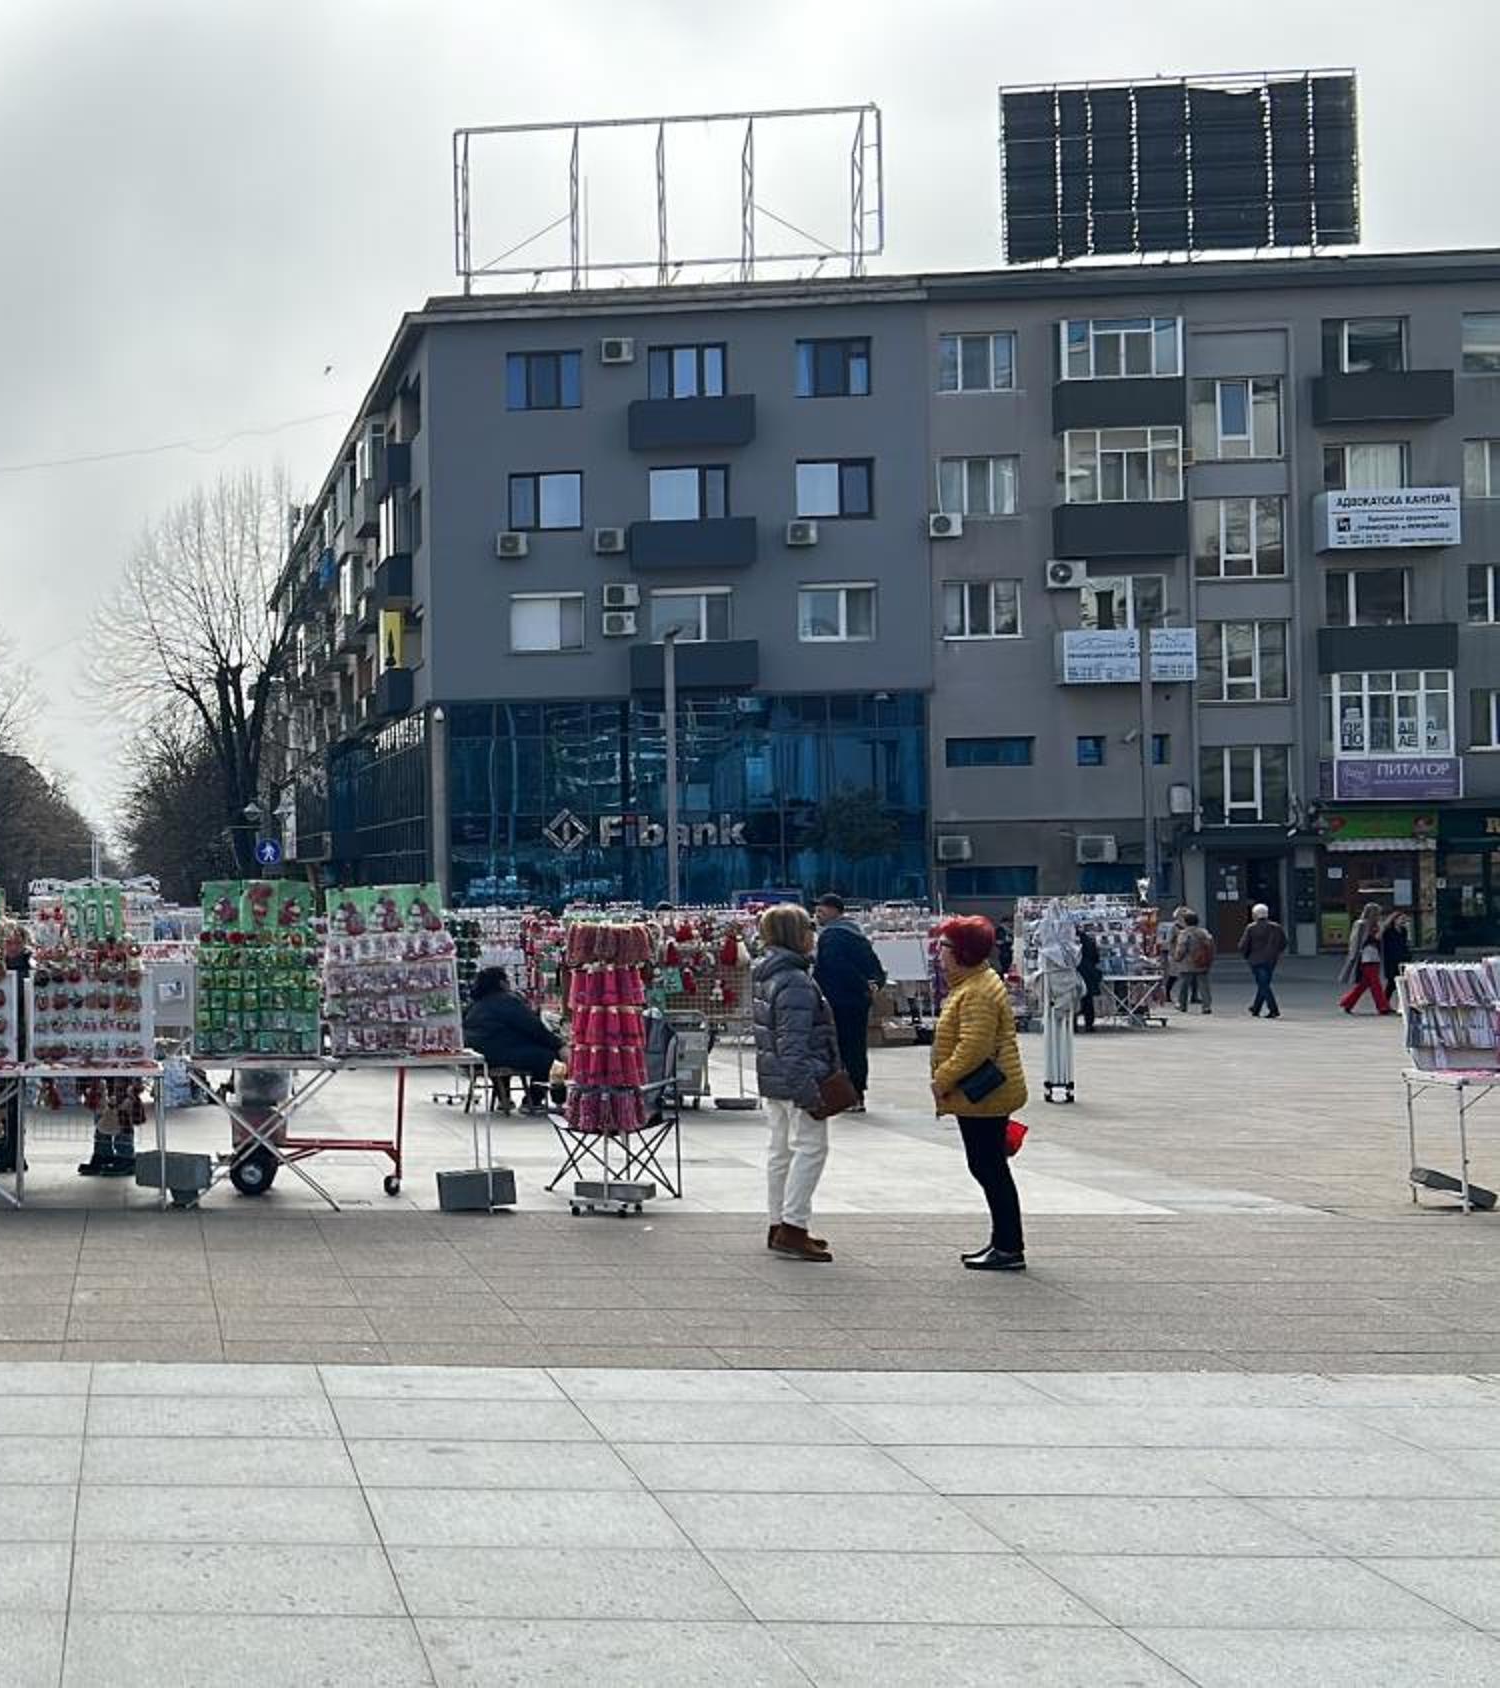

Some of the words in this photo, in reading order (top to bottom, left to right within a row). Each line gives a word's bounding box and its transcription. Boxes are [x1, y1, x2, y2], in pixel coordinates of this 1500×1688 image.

[1336, 495, 1402, 508] АДВОКАТСКА
[1405, 493, 1451, 505] КАНТОРА
[1376, 762, 1450, 777] ПИТАГОР
[600, 813, 747, 848] Fibank
